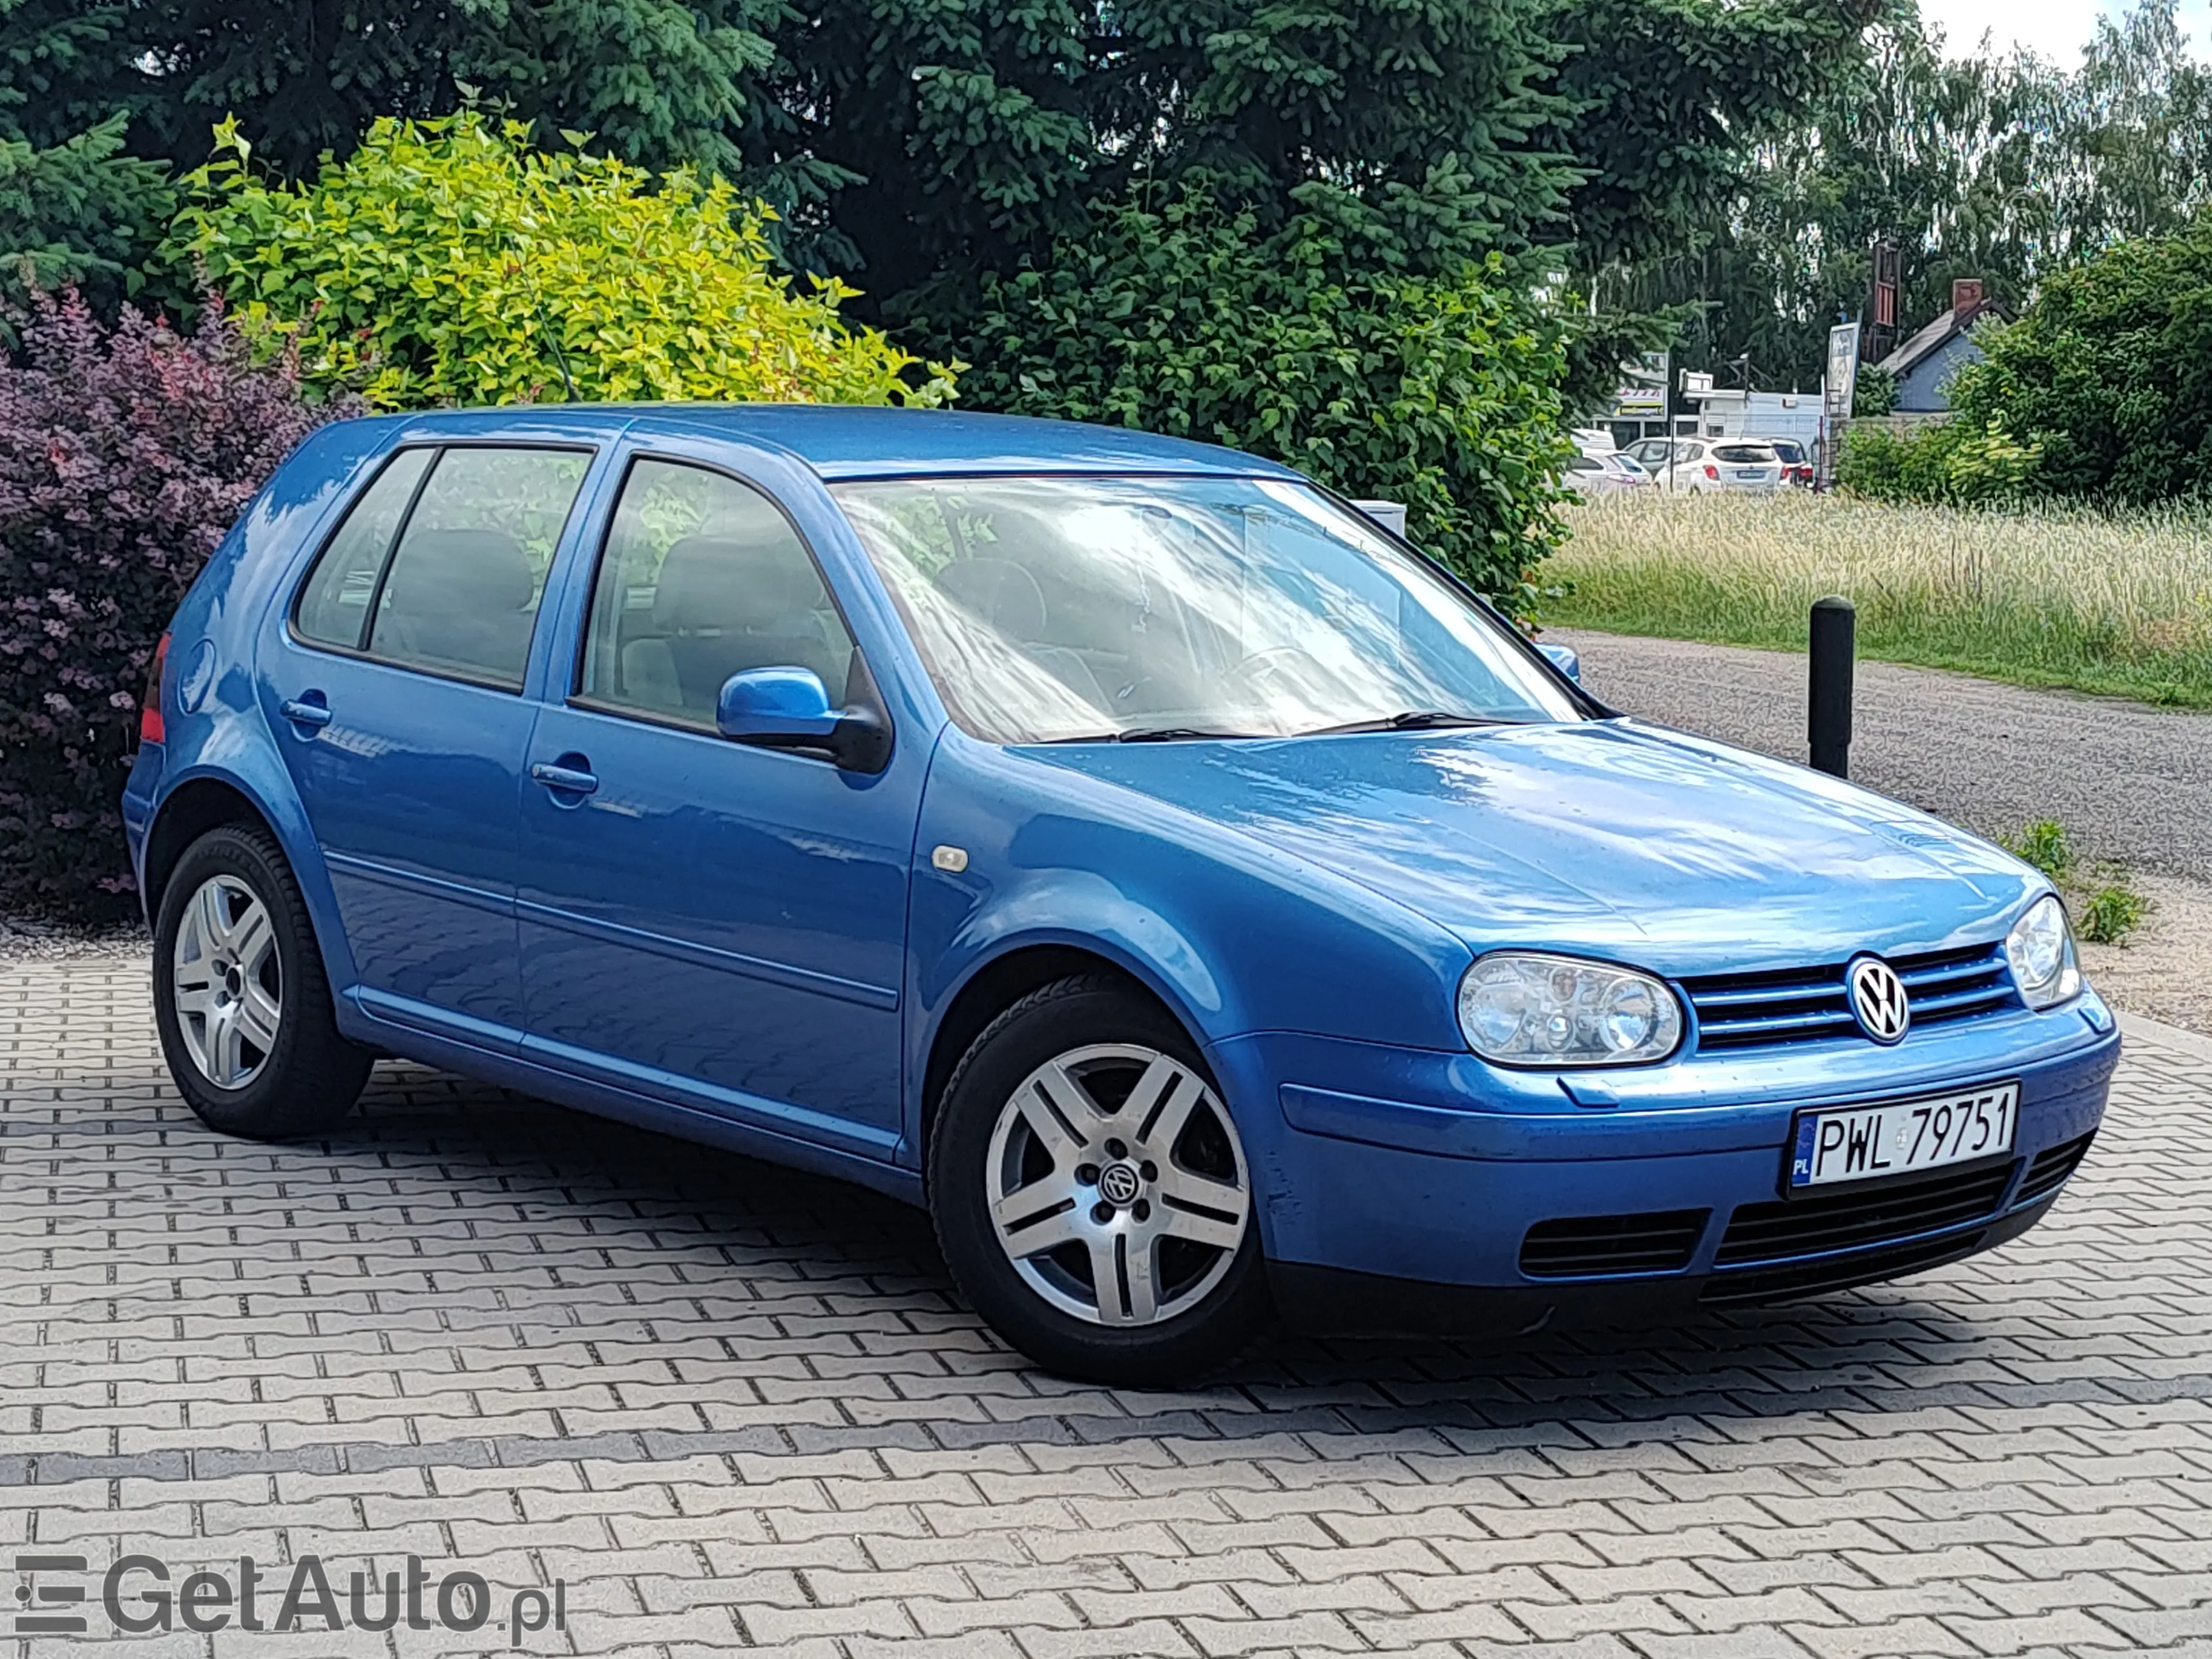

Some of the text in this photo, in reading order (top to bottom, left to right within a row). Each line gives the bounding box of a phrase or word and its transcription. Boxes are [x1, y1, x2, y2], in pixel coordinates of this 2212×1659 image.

[1851, 961, 1910, 1040] VW
[1793, 1158, 1809, 1176] PL
[1815, 1092, 2009, 1177] PWL 79751
